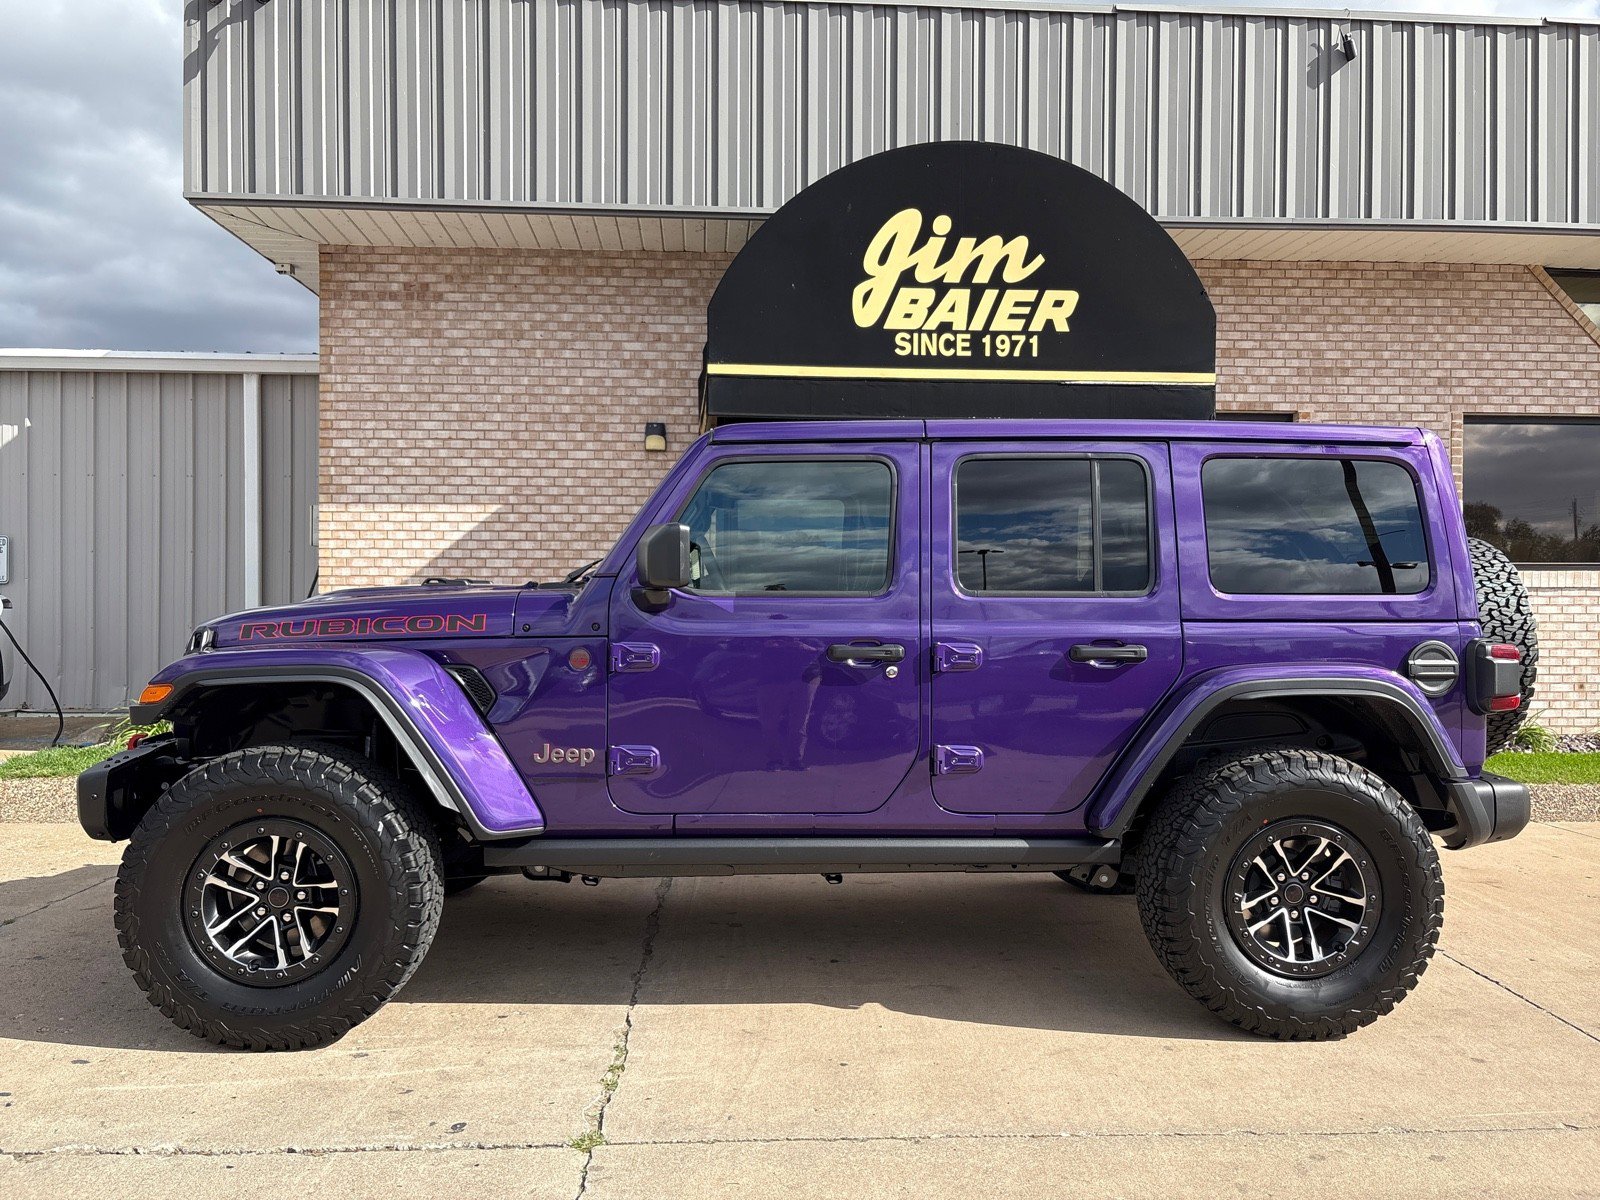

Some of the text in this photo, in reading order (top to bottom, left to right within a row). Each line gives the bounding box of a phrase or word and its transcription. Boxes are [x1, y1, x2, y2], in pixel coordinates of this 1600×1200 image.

[851, 207, 1046, 328] Jim
[883, 287, 1080, 333] BAIER
[894, 332, 1038, 357] SINCE 1971
[238, 613, 487, 640] RUBICON
[533, 743, 596, 767] Jeep
